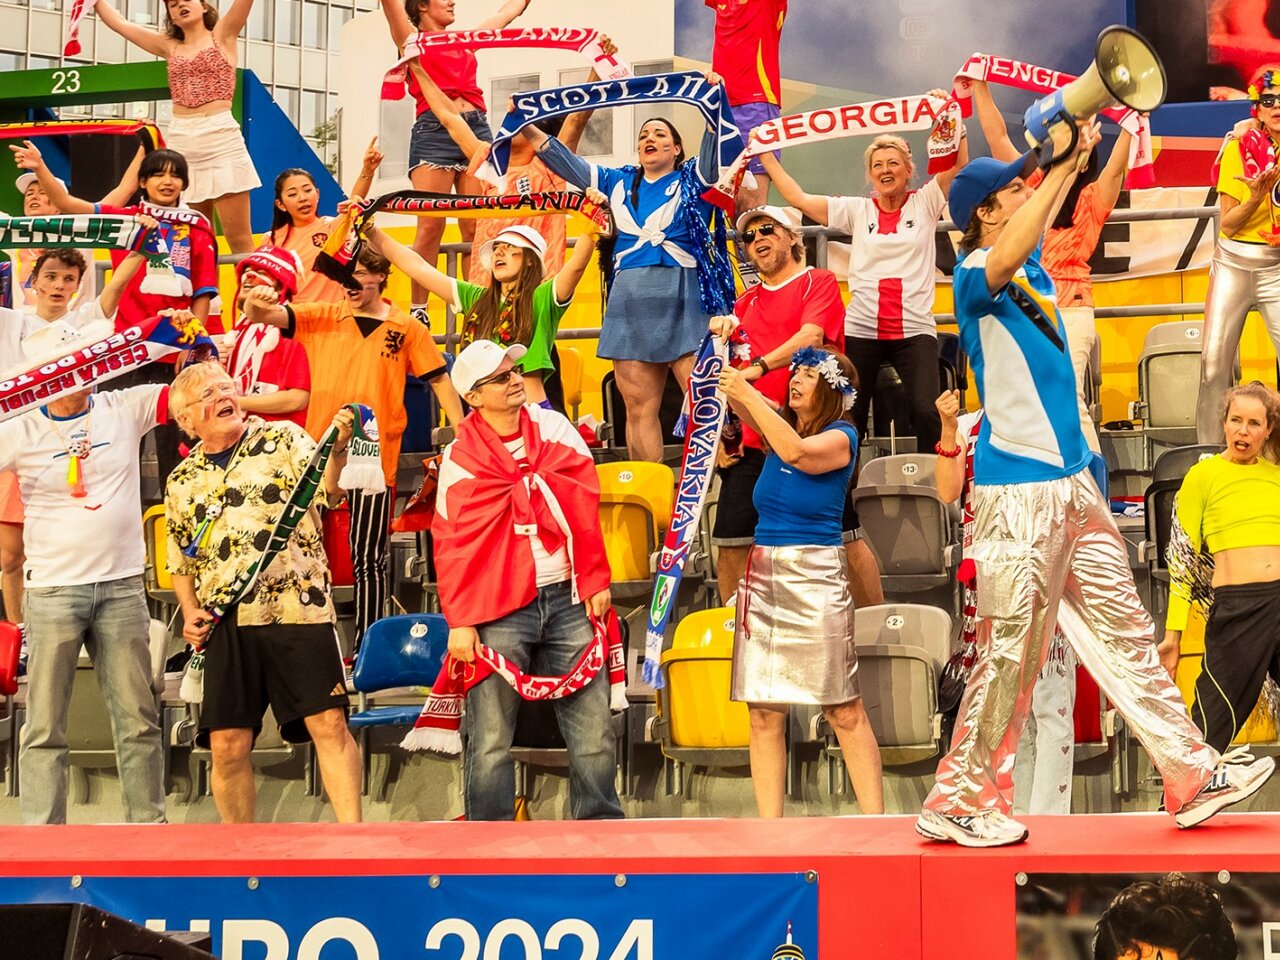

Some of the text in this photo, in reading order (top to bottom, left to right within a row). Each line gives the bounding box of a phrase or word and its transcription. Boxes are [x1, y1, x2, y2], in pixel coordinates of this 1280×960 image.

[425, 27, 589, 47] ENGLAND
[51, 70, 81, 93] 23
[991, 57, 1069, 89] ENGL
[517, 76, 720, 120] SCOTLAND
[756, 98, 933, 145] GEORGIA
[75, 343, 151, 387] ČESKÁ
[672, 355, 722, 532] SLOVAKIA
